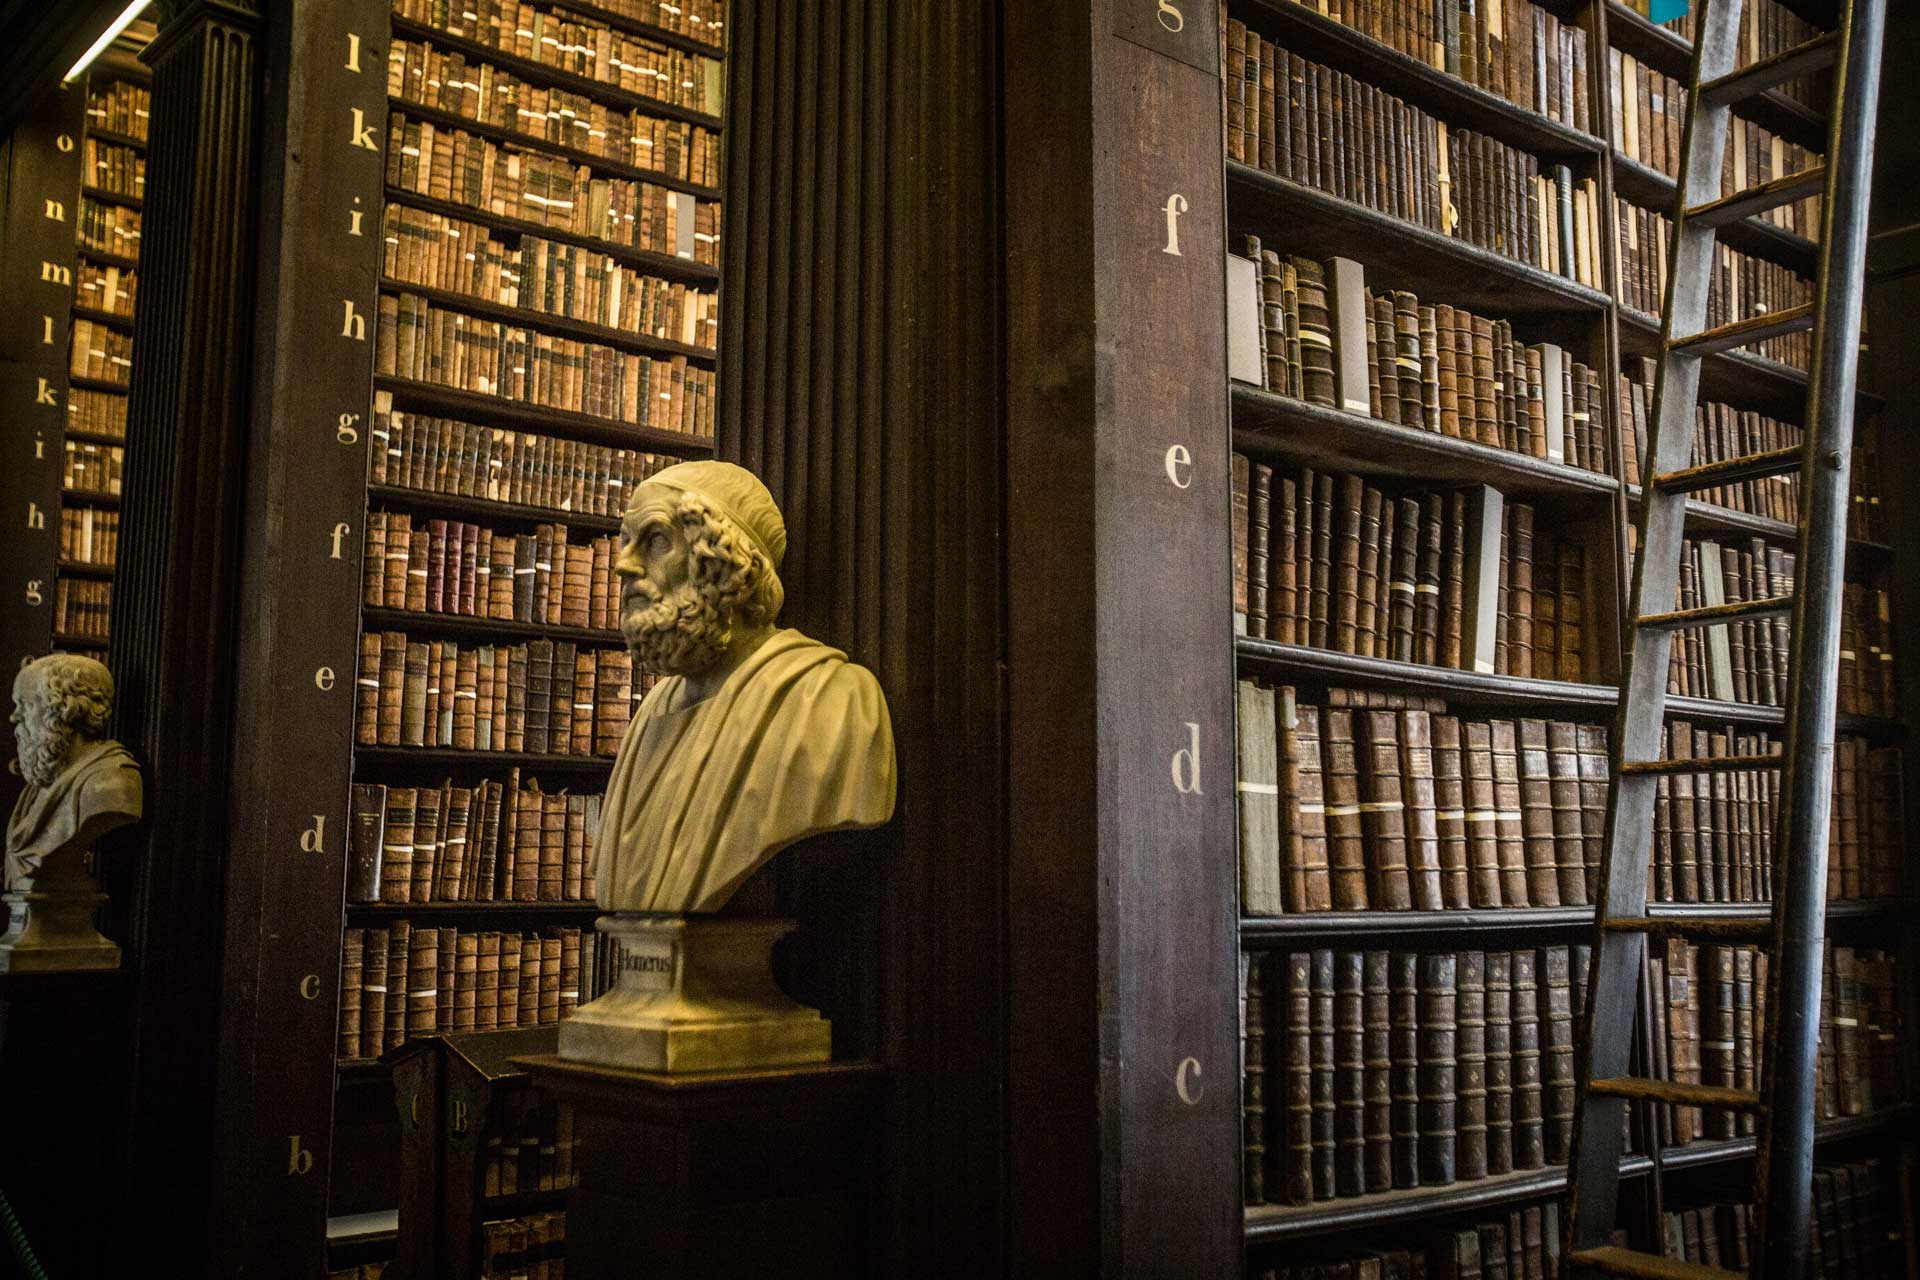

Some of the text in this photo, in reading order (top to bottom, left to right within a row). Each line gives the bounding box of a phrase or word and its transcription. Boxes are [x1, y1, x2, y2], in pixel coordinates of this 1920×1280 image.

[56, 133, 74, 153] o
[350, 108, 379, 152] k
[45, 199, 65, 222] n
[348, 196, 364, 237] i
[1161, 194, 1189, 257] f
[41, 261, 71, 286] m
[341, 300, 366, 341] h
[36, 378, 57, 406] k
[35, 432, 44, 459] i
[336, 413, 360, 444] g
[1165, 445, 1193, 490] e
[28, 503, 45, 530] h
[329, 522, 351, 561] f
[26, 579, 43, 606] g
[315, 667, 335, 691] e
[1171, 721, 1204, 795] d
[300, 814, 325, 854] d
[300, 974, 320, 1000] c
[1175, 1056, 1205, 1106] c
[287, 1135, 313, 1176] b
